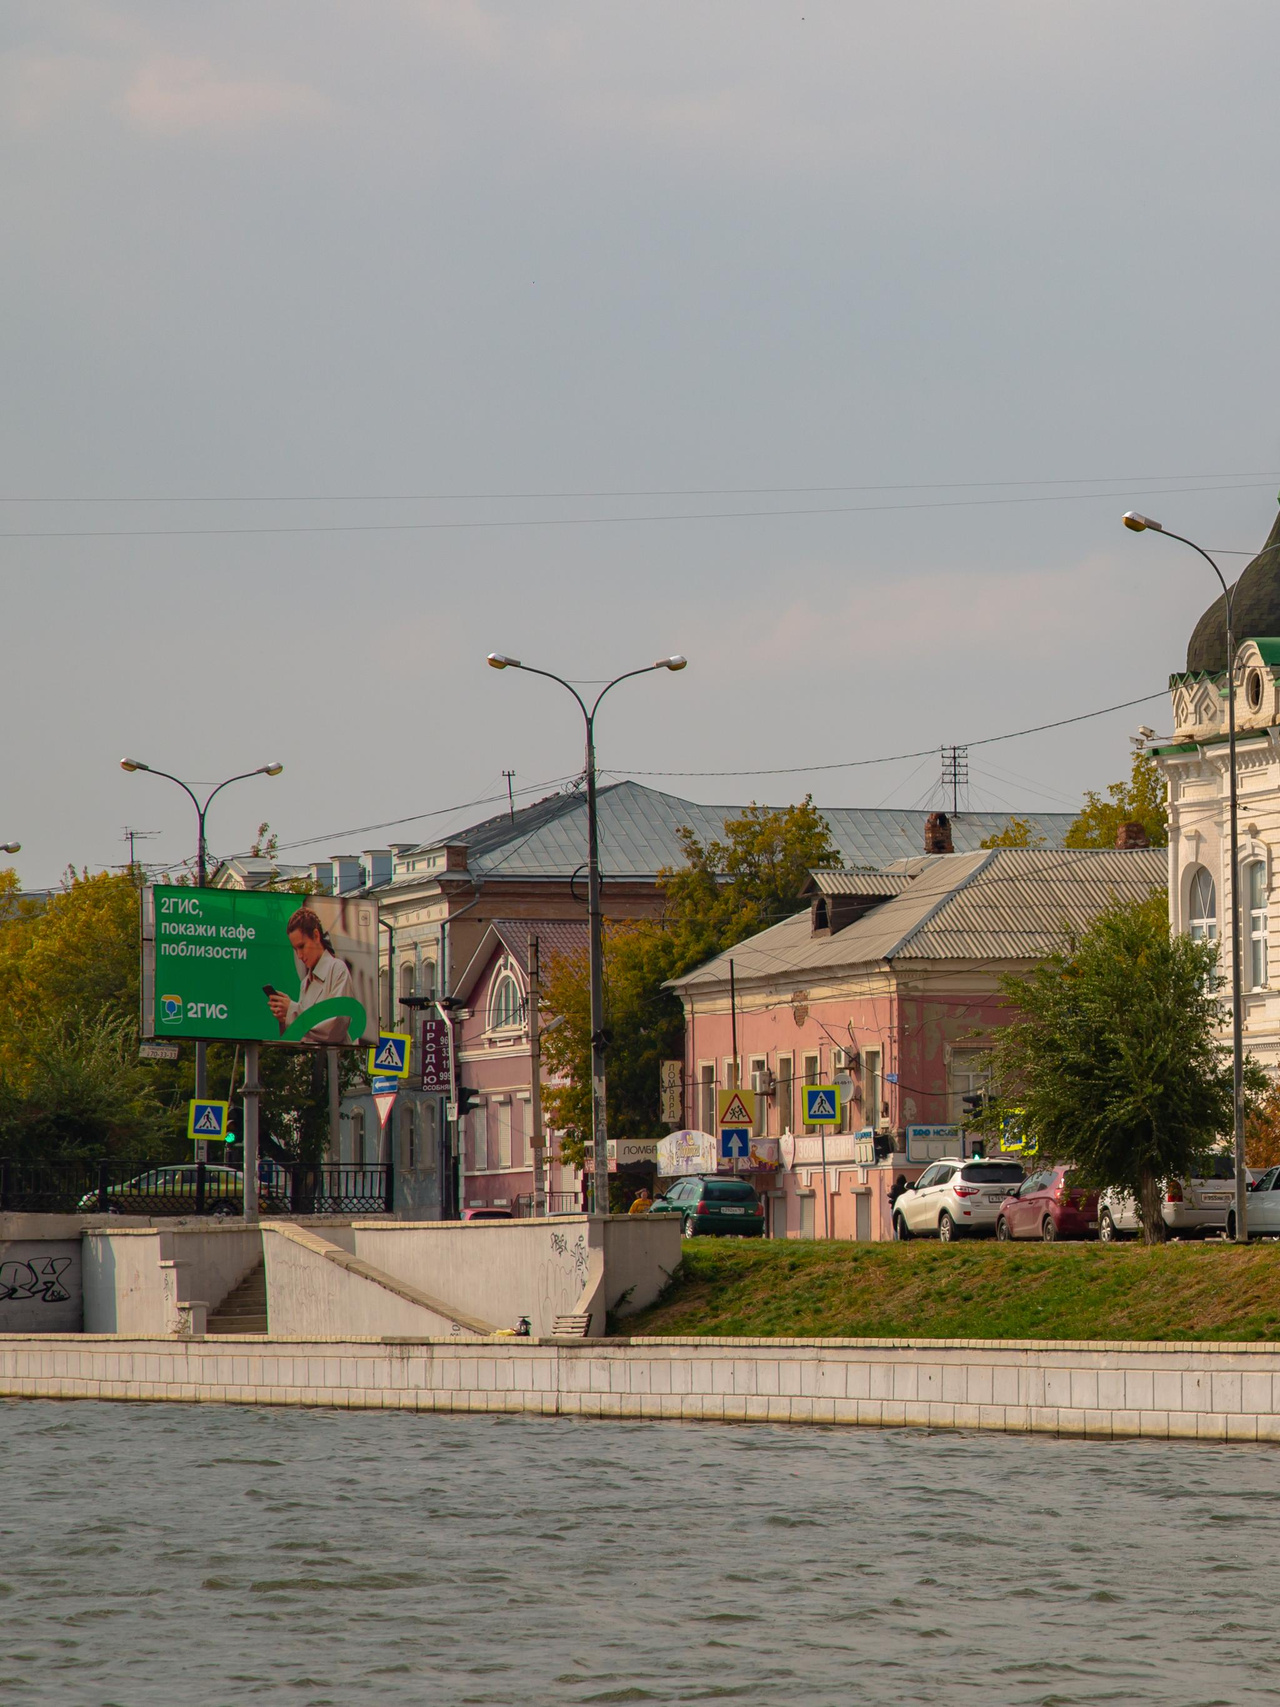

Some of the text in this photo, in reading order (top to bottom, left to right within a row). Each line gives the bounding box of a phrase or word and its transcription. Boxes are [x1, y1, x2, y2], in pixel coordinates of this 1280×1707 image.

[161, 898, 203, 918] 2ГИС,
[161, 922, 256, 942] покажи кафе
[161, 941, 247, 960] поблизости
[187, 1003, 228, 1019] 2ГИС
[424, 1022, 437, 1084] ПРОДАЮ
[667, 1064, 676, 1119] ЛОМБАРД
[798, 1138, 852, 1159] ЗООМГАЗИН
